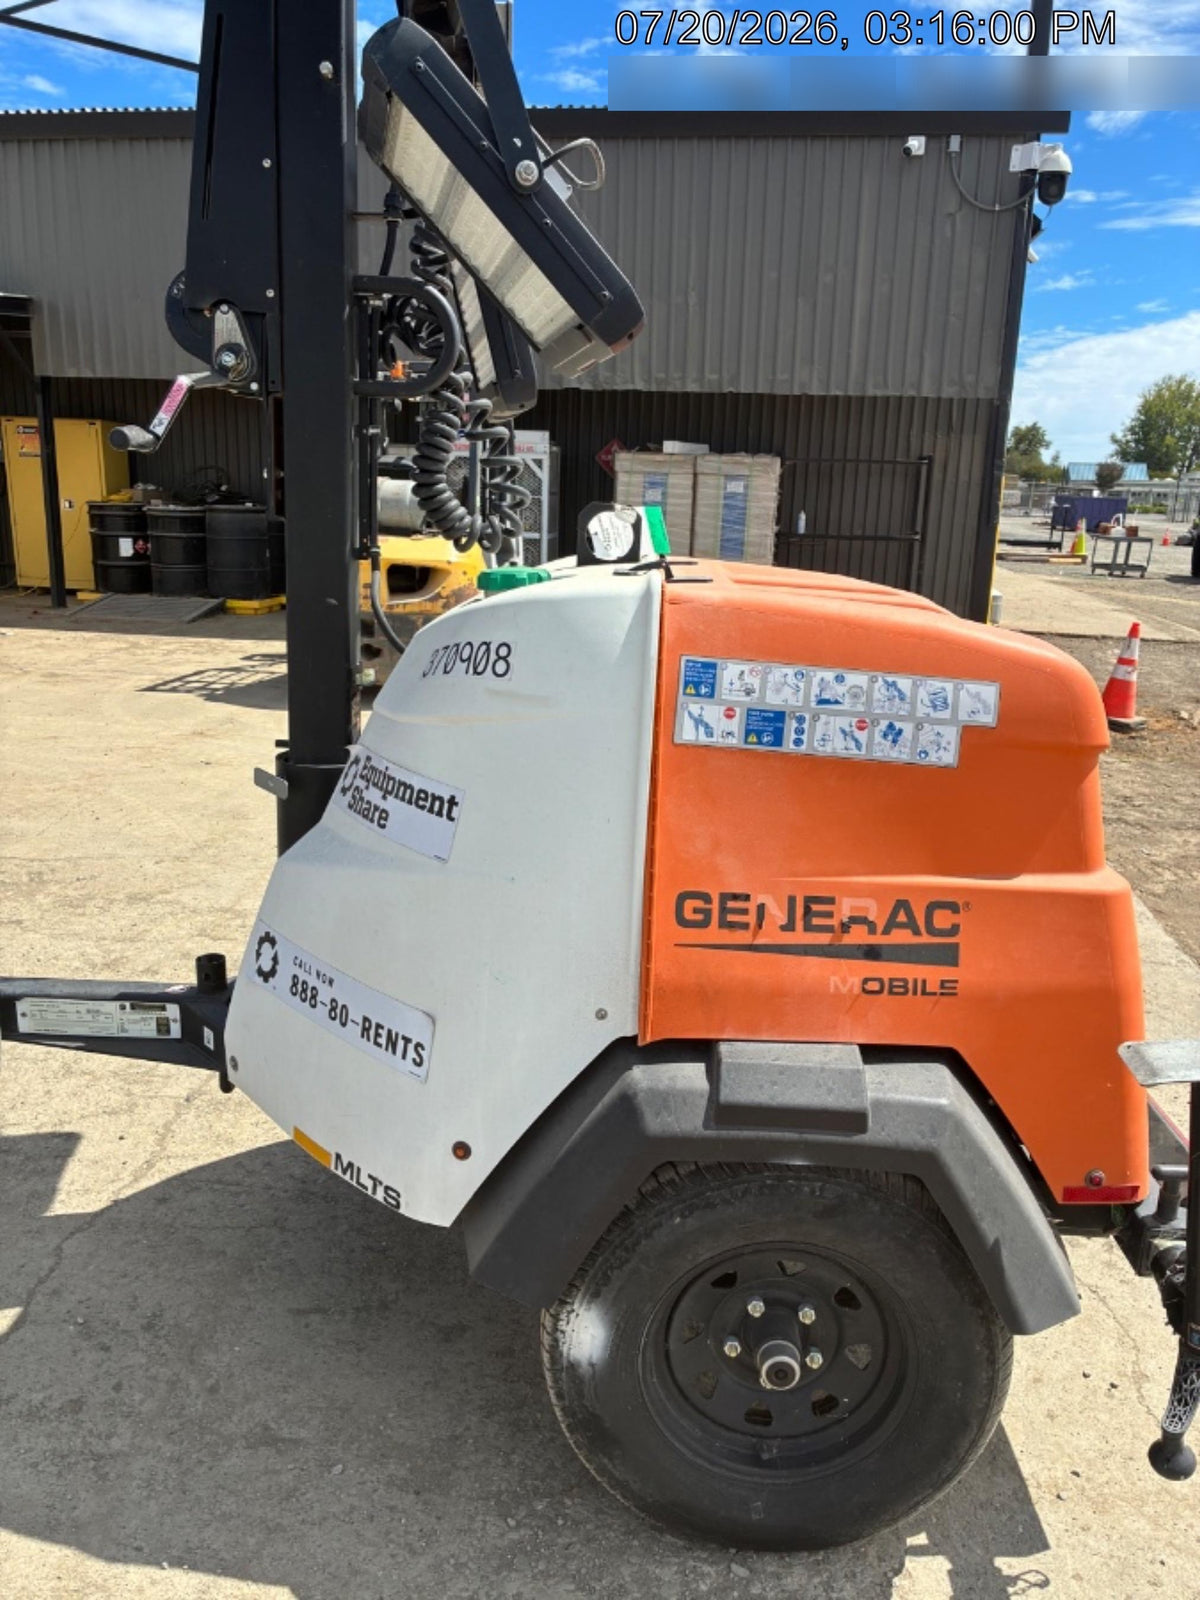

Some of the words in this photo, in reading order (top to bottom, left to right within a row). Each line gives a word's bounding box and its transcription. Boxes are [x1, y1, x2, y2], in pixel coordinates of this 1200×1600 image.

[347, 785, 390, 829] Share
[359, 755, 459, 822] Equipment
[674, 890, 961, 937] GENERAC
[292, 955, 313, 976] CALL
[315, 967, 335, 988] NOW
[289, 973, 426, 1068] 888-80-RENTS
[334, 1151, 402, 1210] MLTS
